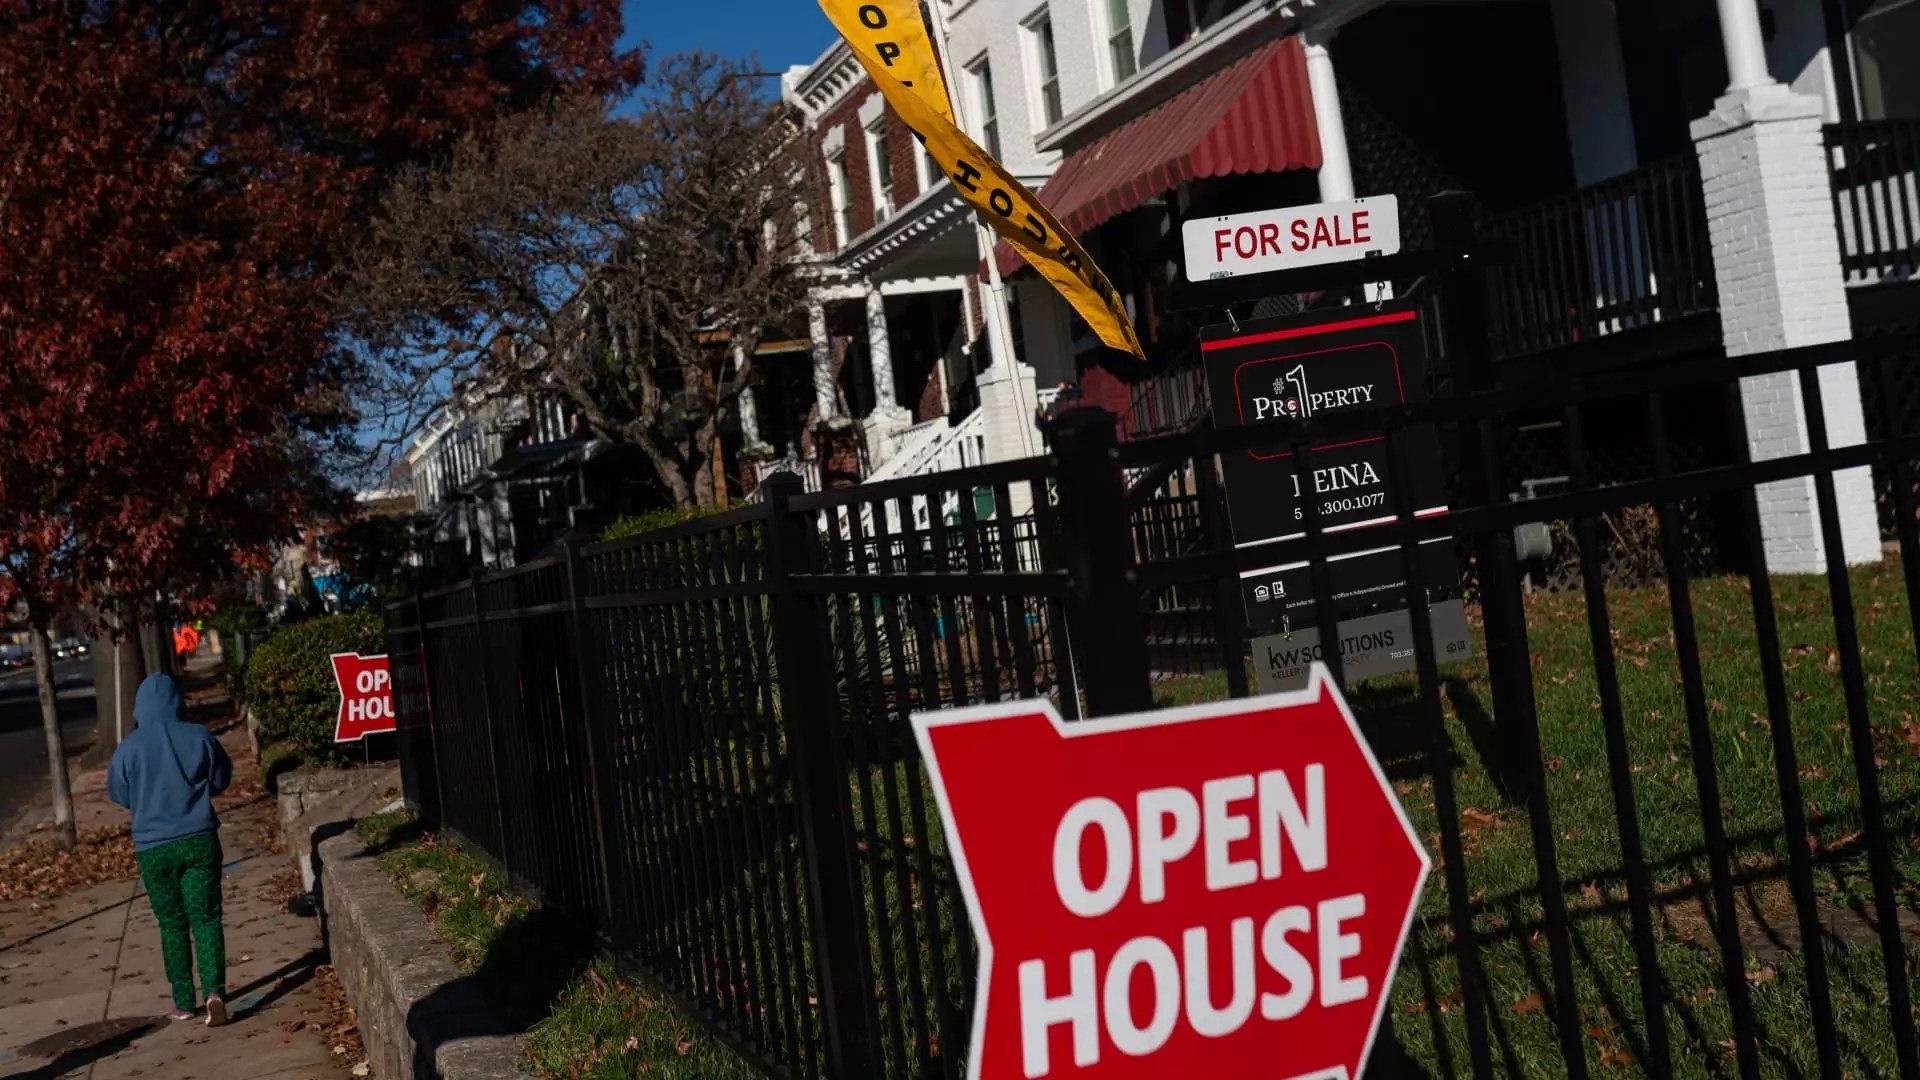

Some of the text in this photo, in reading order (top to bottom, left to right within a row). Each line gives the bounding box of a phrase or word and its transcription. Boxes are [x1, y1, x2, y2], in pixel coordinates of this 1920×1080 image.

[1214, 211, 1371, 262] FOR SALE
[1294, 492, 1385, 520] 5.300.1077
[1301, 630, 1394, 663] SOUTIONS
[356, 669, 392, 693] OP
[348, 695, 395, 722] HOU
[1053, 763, 1327, 917] OPEN
[1018, 893, 1368, 1079] HOUSE
